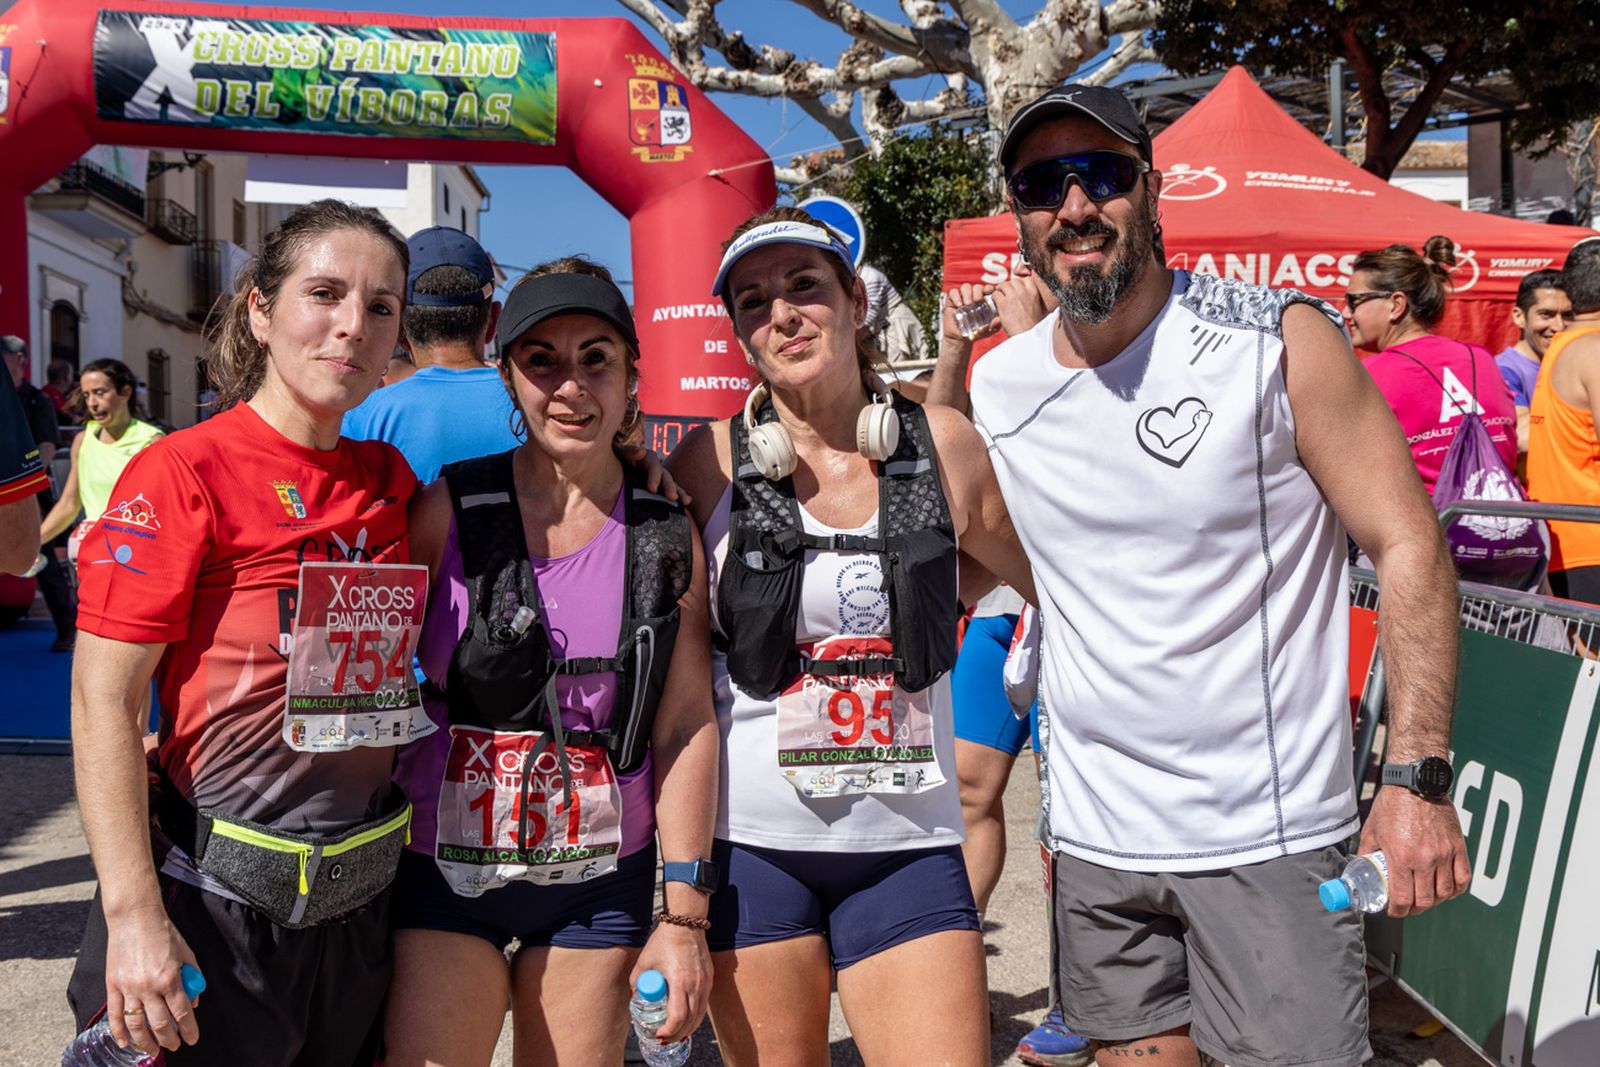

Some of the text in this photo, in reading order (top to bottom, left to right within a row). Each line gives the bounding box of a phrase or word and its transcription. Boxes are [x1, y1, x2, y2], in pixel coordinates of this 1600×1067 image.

[124, 17, 521, 122] X CROSS PANTANO
[195, 77, 512, 129] DEL VÍBORAS
[1245, 171, 1351, 187] YOMURY
[1490, 258, 1553, 268] YOMURY
[652, 304, 729, 323] AYUNTAM
[704, 340, 728, 354] DE
[681, 376, 750, 391] MARTOS
[327, 575, 415, 610] X CROSS
[326, 611, 402, 634] PANTANO
[327, 628, 411, 694] 754
[828, 690, 894, 746] 95
[464, 737, 493, 769] X
[780, 750, 817, 764] PILAR
[469, 788, 581, 847] 151
[443, 846, 479, 862] ROSA
